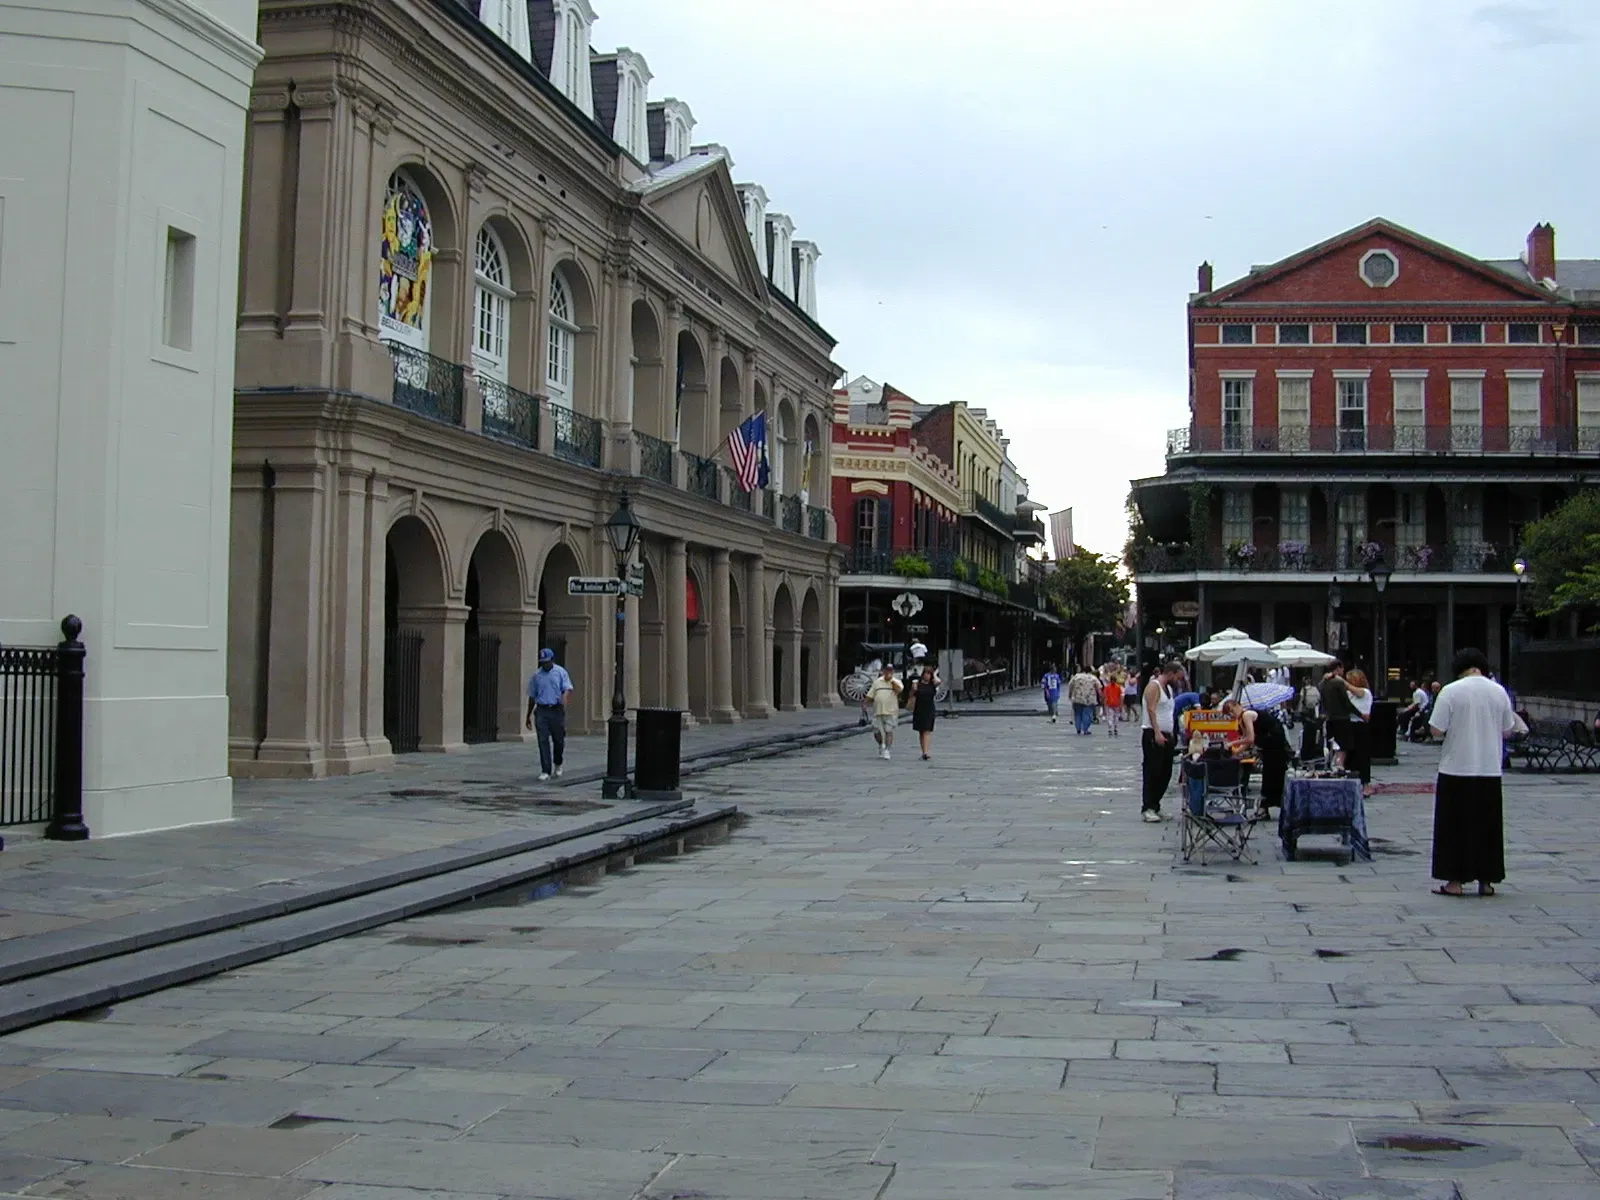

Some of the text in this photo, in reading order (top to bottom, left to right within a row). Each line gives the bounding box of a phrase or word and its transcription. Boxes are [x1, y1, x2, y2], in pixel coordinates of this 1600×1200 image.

[381, 316, 411, 336] BELLSOUTH
[584, 582, 603, 592] Antoine
[605, 582, 617, 594] Alley
